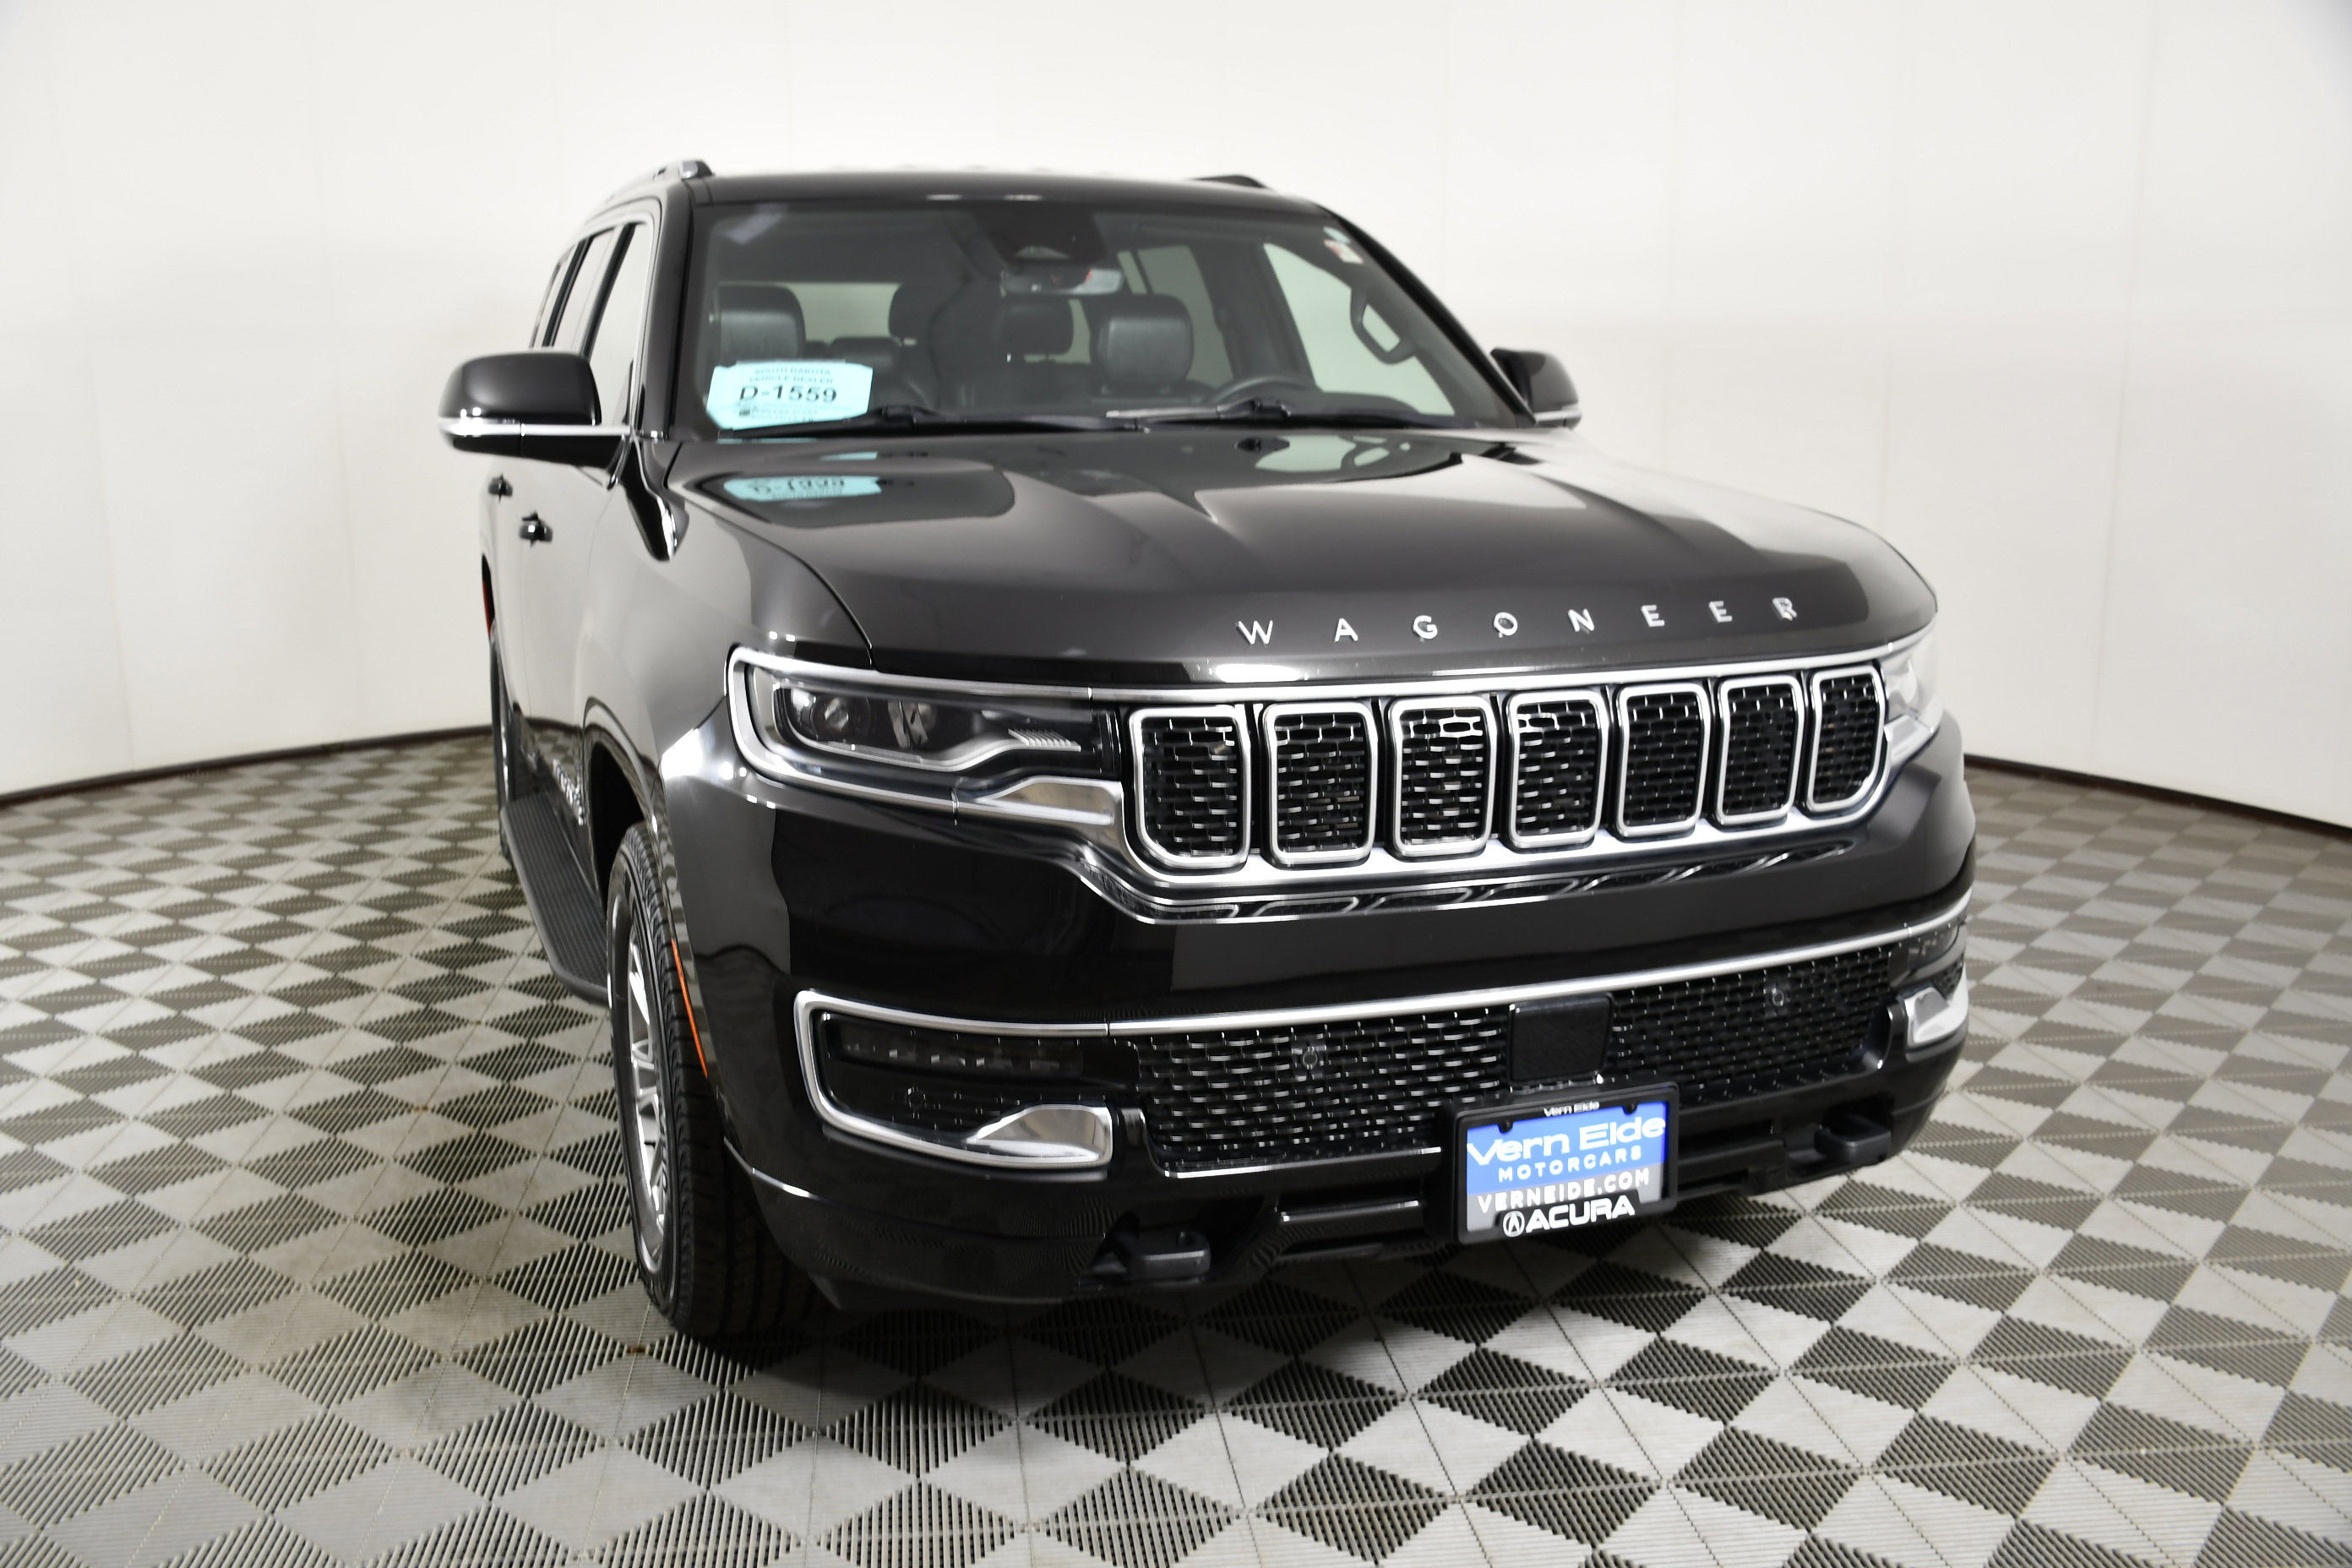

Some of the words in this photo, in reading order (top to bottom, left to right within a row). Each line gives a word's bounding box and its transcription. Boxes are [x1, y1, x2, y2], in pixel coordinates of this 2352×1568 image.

[739, 384, 837, 403] D-1559
[1237, 596, 1798, 645] WAGONEER
[1544, 1105, 1572, 1118] Vern
[1467, 1133, 1570, 1166] Vern
[1498, 1145, 1642, 1183] MOTORCARS
[1478, 1168, 1649, 1214] VERNEIDE.COM
[1525, 1195, 1636, 1233] ACURA
